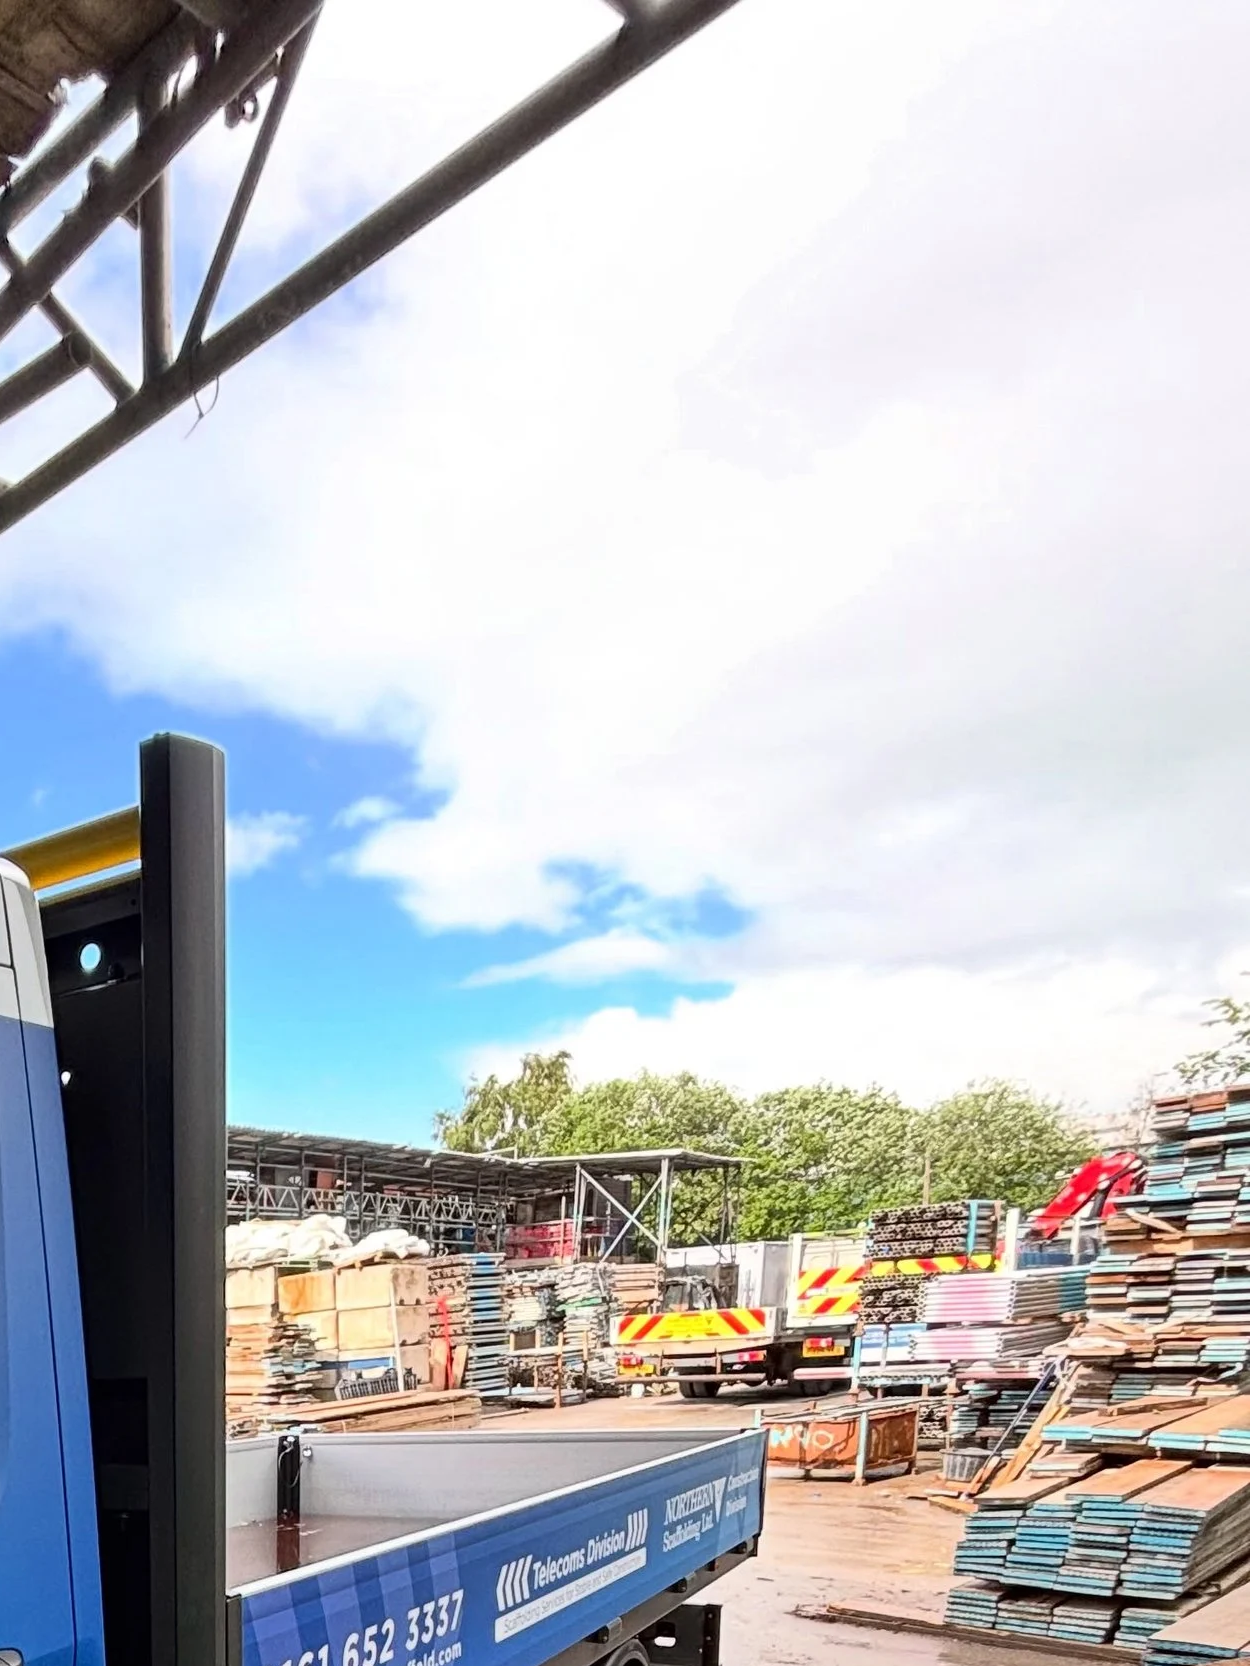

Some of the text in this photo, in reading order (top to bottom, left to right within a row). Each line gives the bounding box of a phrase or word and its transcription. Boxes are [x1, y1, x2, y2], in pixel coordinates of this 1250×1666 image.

[663, 1482, 714, 1526] NORTHERN
[662, 1510, 714, 1552] Scaffolding Ltd.
[533, 1529, 626, 1590] Telecoms Division
[405, 1588, 464, 1651] 3337
